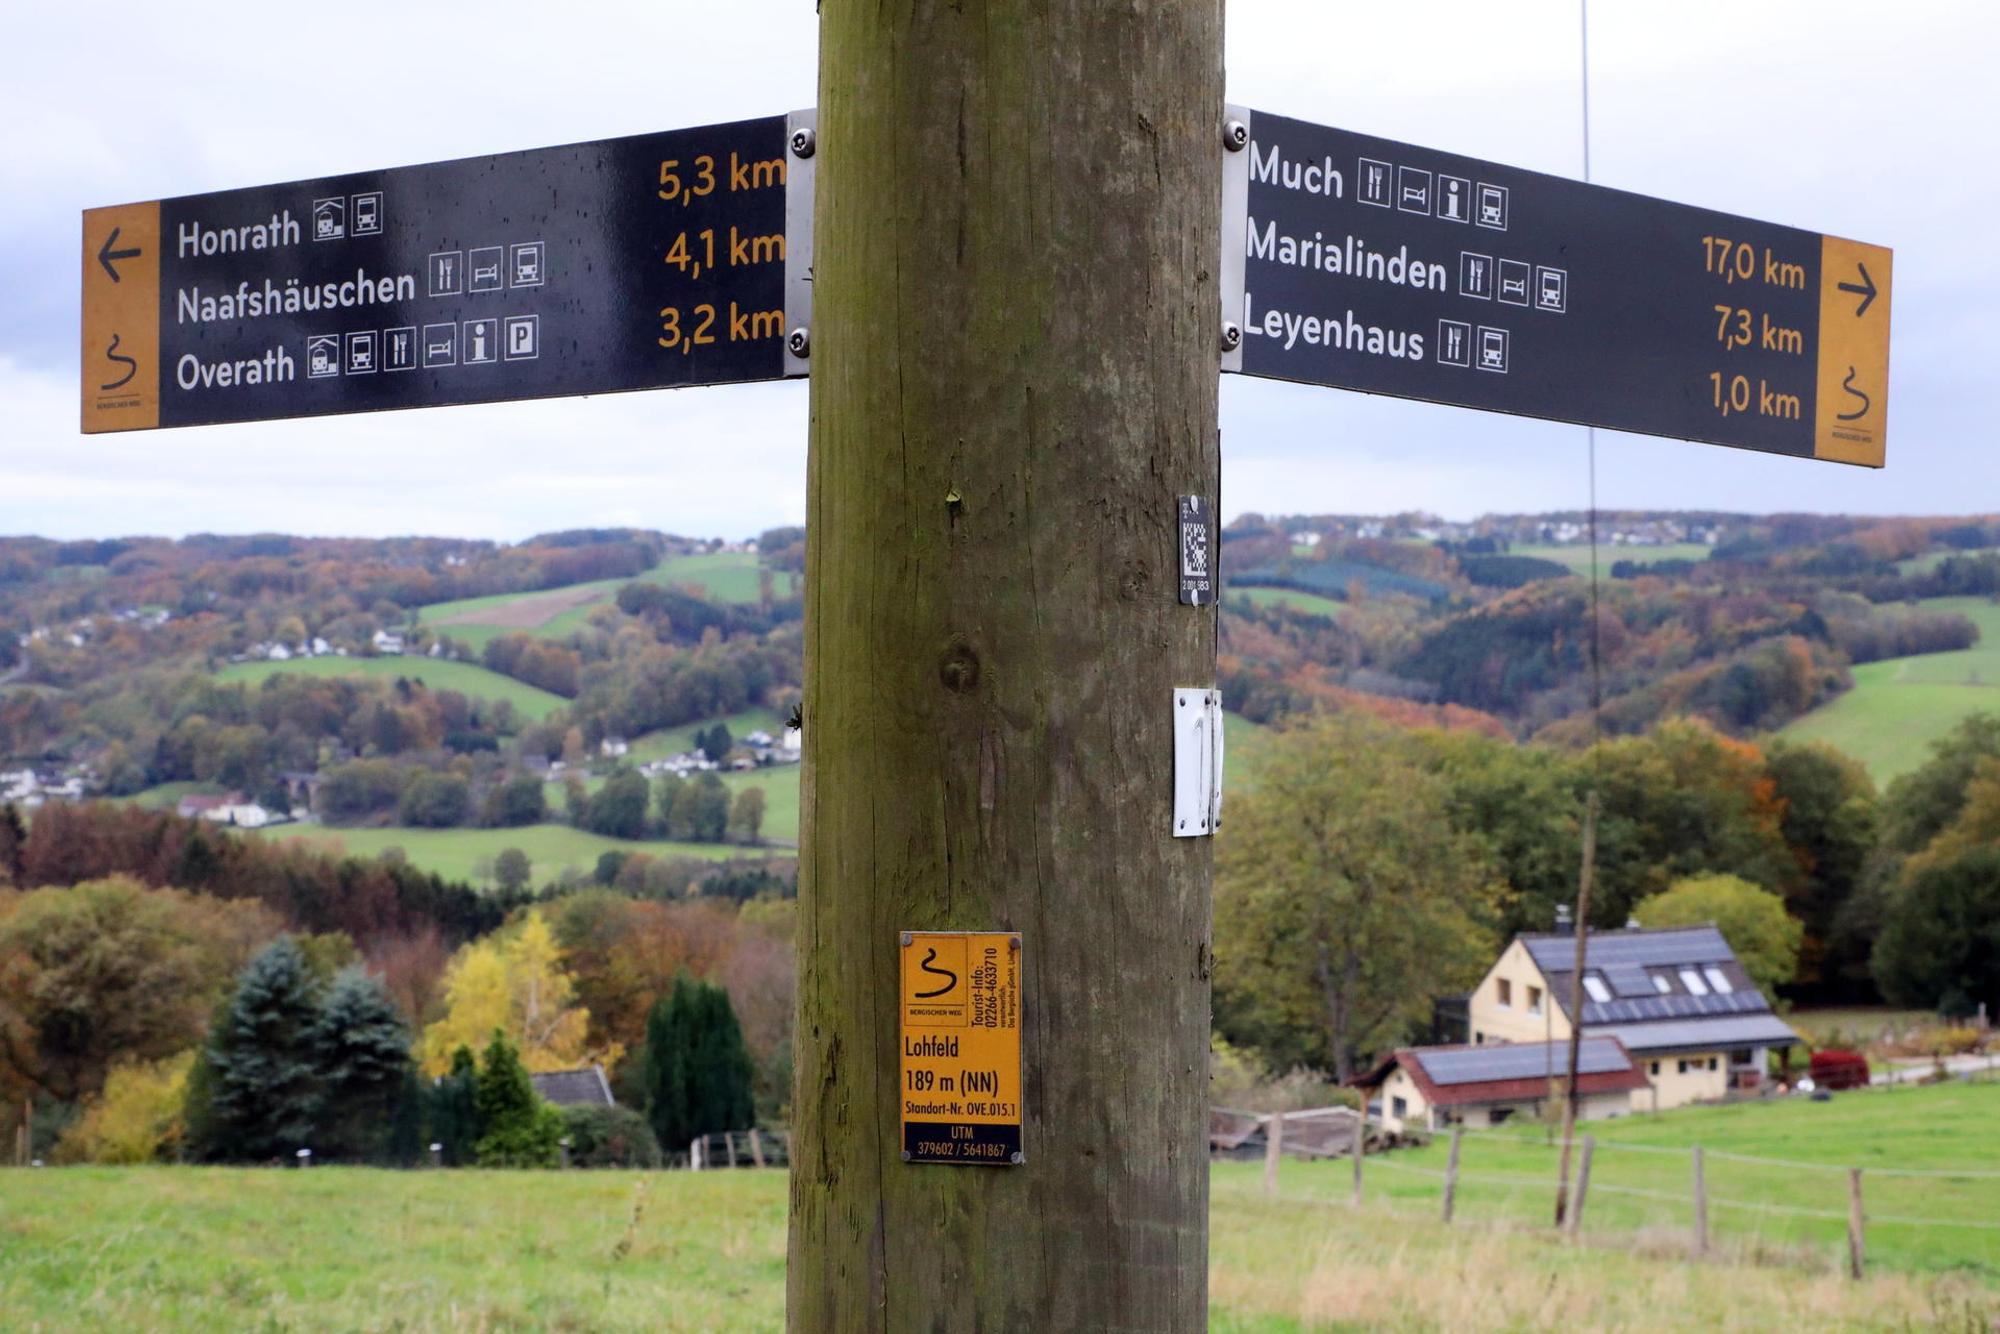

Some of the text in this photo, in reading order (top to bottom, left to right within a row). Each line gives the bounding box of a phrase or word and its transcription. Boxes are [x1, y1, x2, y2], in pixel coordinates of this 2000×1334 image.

[657, 151, 787, 207] 5,3 km
[1249, 140, 1343, 198] Much
[178, 209, 301, 259] Honrath
[664, 225, 786, 280] 4,1 km
[1246, 216, 1447, 292] Marialinden
[1702, 235, 1805, 290] 17,0 km
[177, 267, 416, 325] Naafshäuschen
[657, 301, 785, 356] 3,2 km
[1243, 292, 1425, 361] Leyenhaus
[1714, 304, 1803, 355] 7,3 km
[176, 345, 295, 391] Overath
[1709, 371, 1800, 421] 1,0 km
[970, 965, 984, 1028] Tourist-Info:
[985, 947, 998, 1028] 02266-4633710
[905, 1035, 959, 1057] Lohfeld
[905, 1101, 1016, 1117] Standort-Nr. OVE.015.1
[906, 1069, 998, 1098] 189 m (NN)
[917, 1143, 954, 1156] 379602
[963, 1144, 1006, 1158] 5641867
[951, 1126, 974, 1140] UTM
